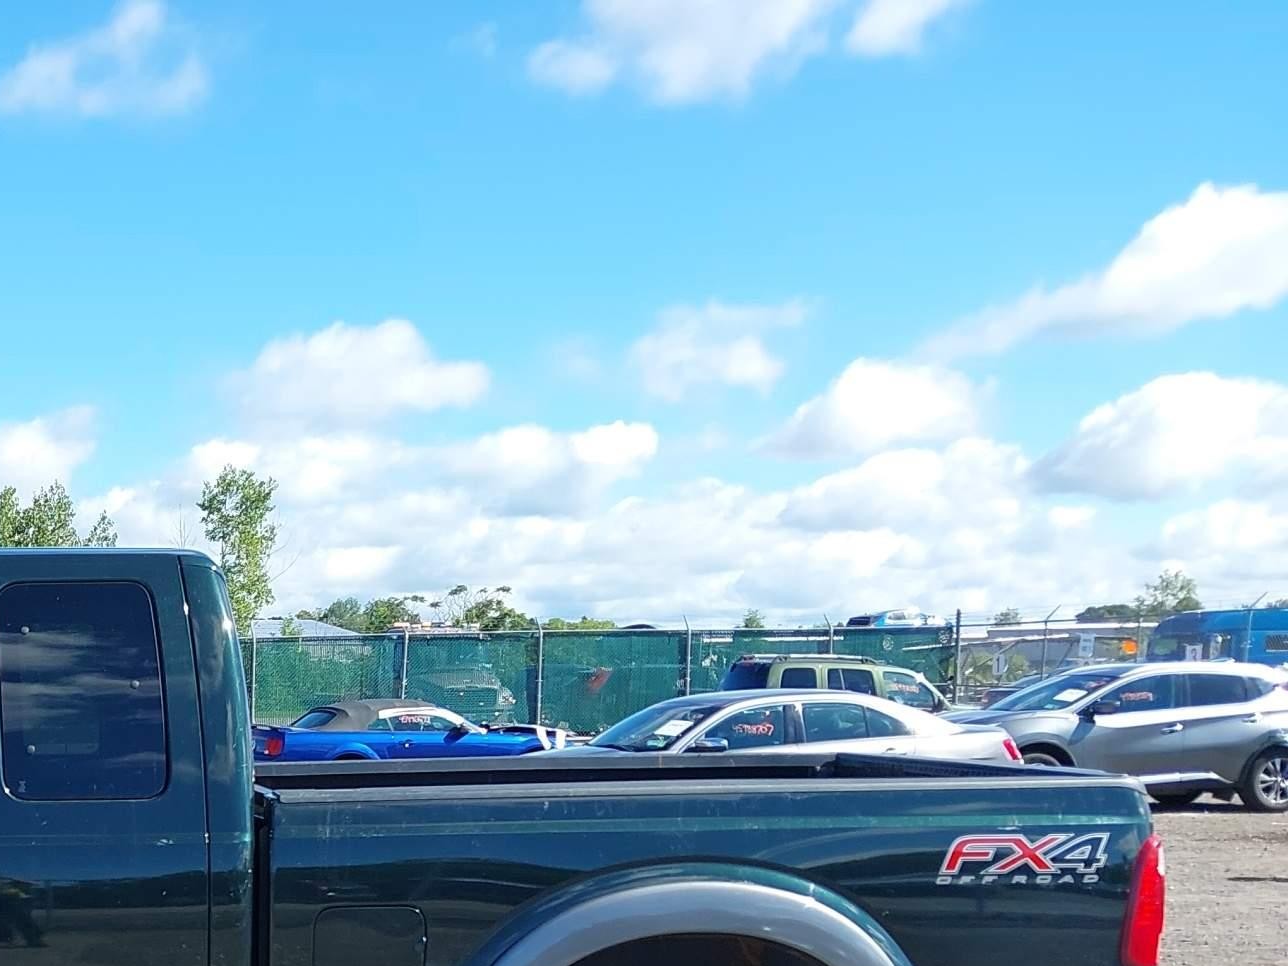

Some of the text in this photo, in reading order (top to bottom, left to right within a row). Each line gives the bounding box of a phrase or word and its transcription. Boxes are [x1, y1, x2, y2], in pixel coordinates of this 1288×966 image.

[938, 833, 1110, 875] FX4
[935, 874, 1099, 885] OFF ROAD
